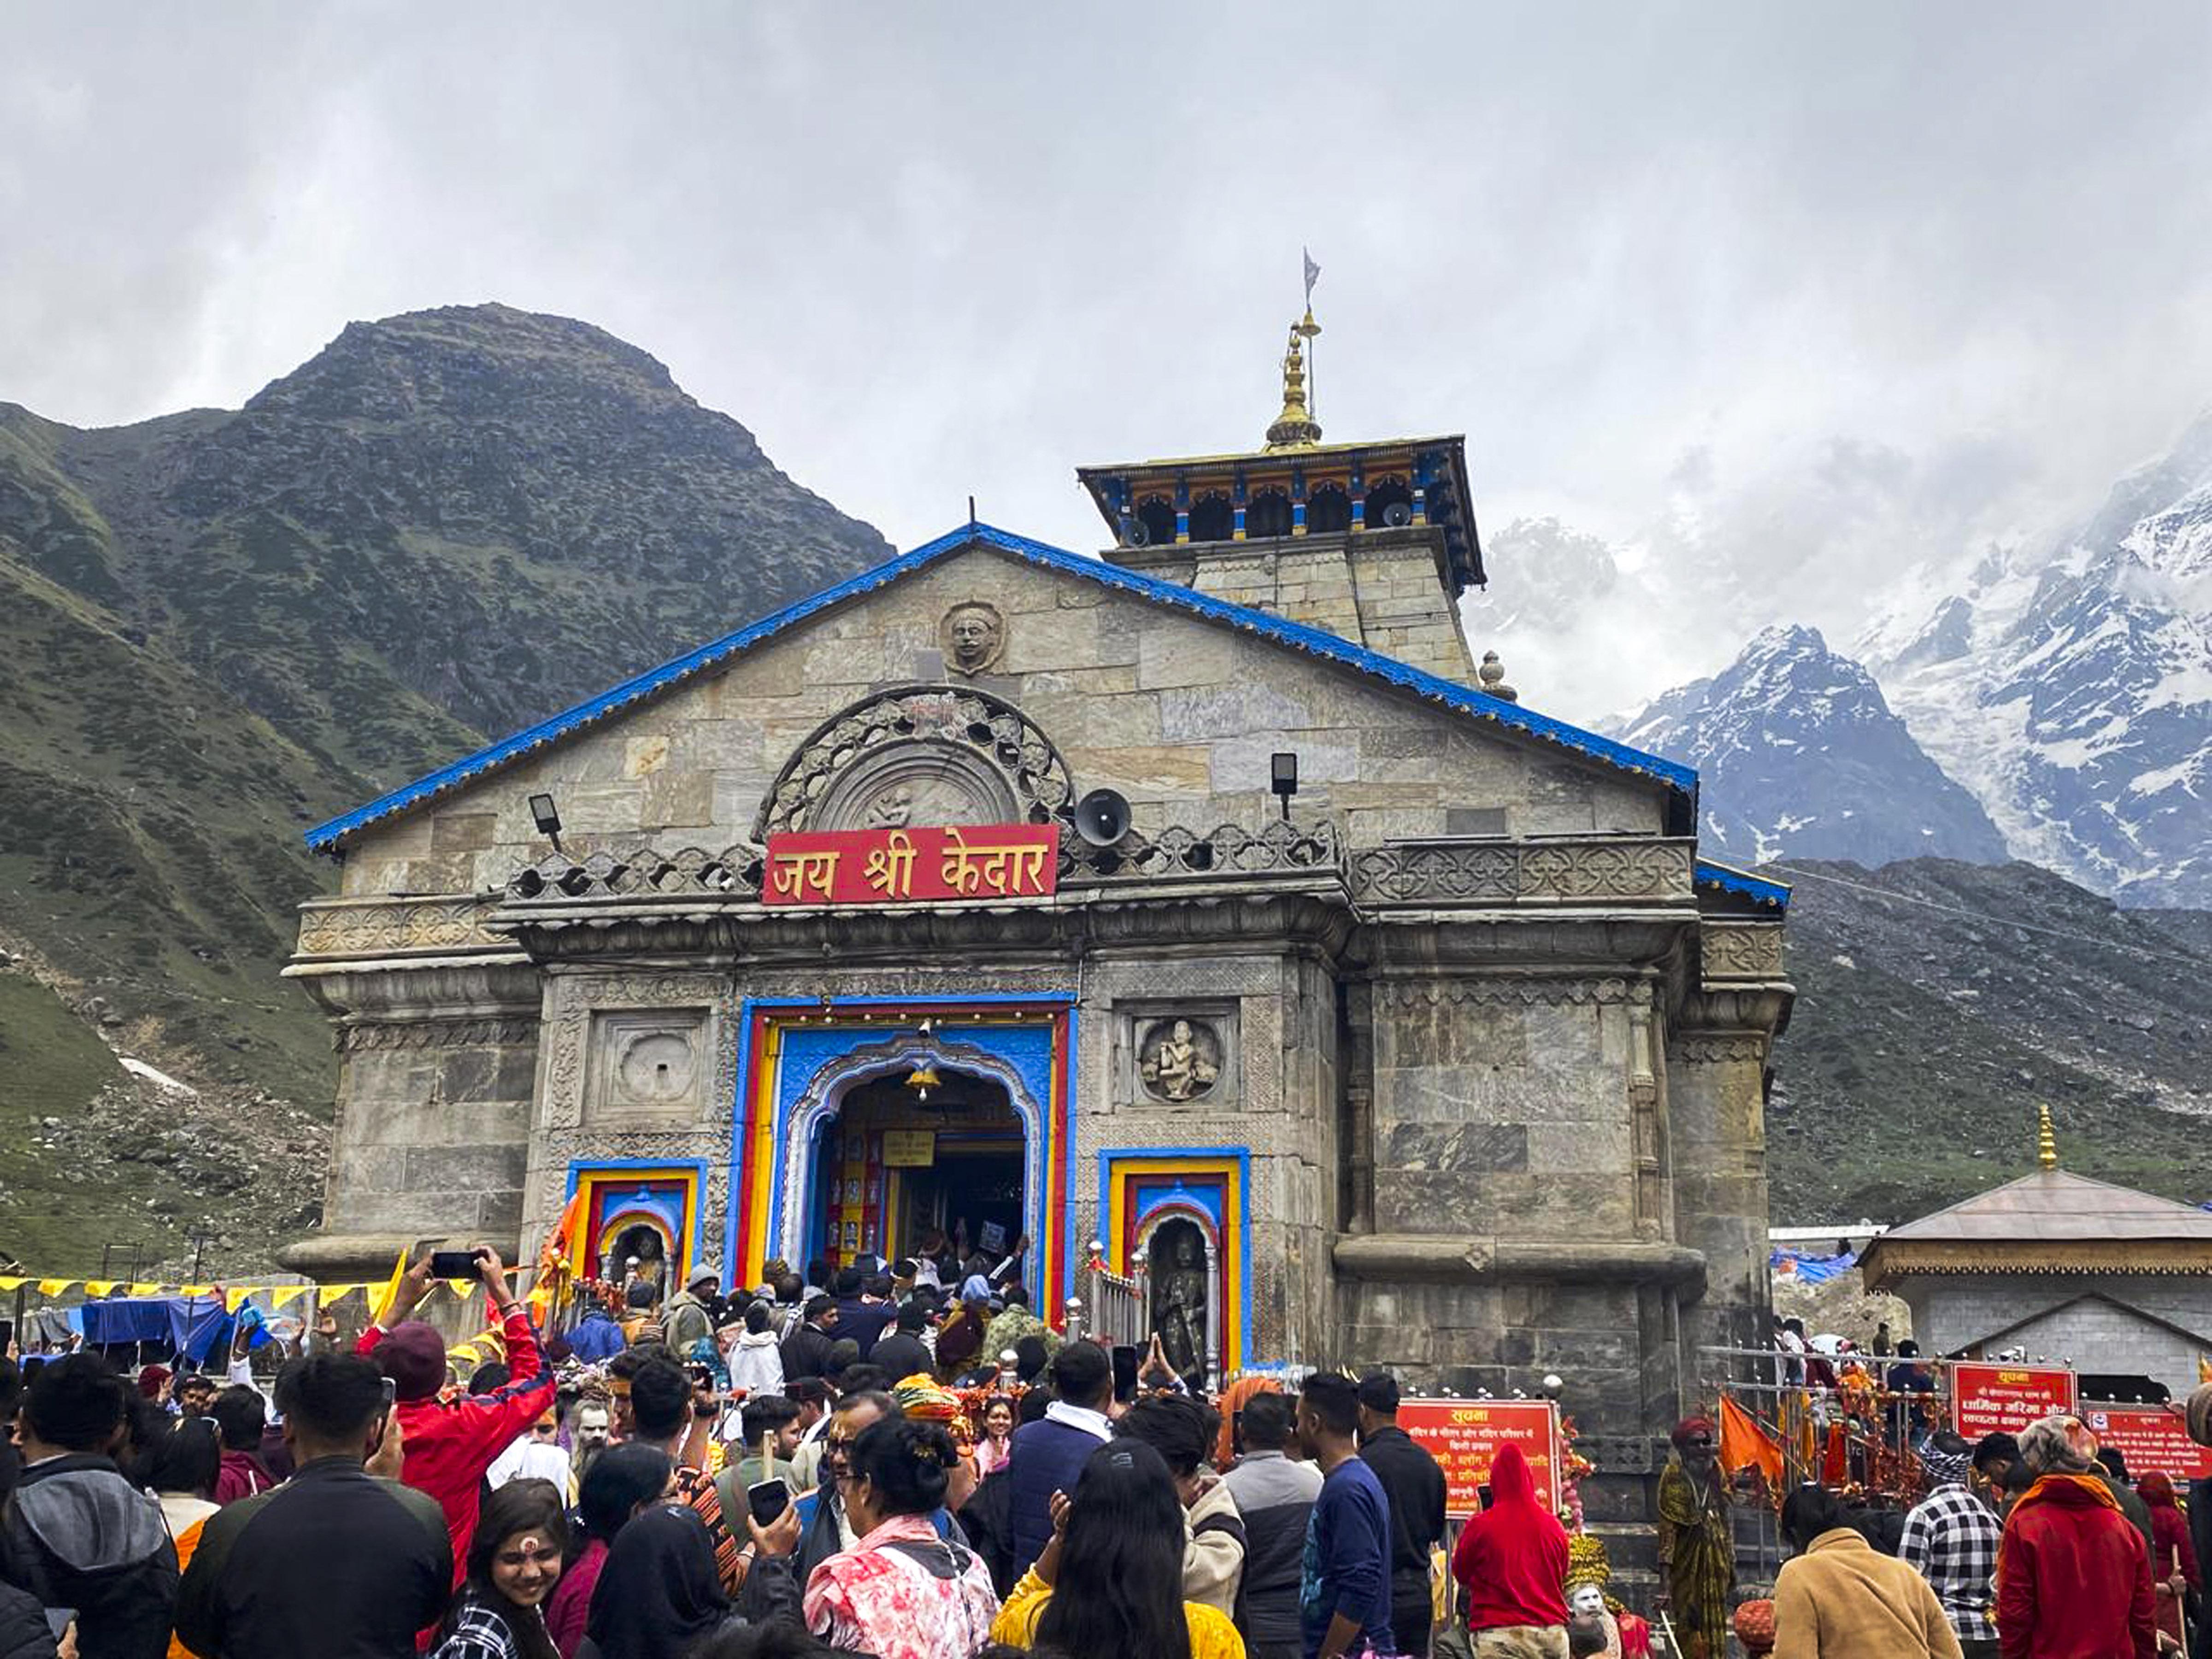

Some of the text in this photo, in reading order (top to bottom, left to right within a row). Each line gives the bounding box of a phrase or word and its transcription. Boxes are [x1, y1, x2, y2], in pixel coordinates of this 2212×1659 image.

[773, 827, 1048, 902] जय श्री केदार
[1452, 1410, 1488, 1424] सूचना
